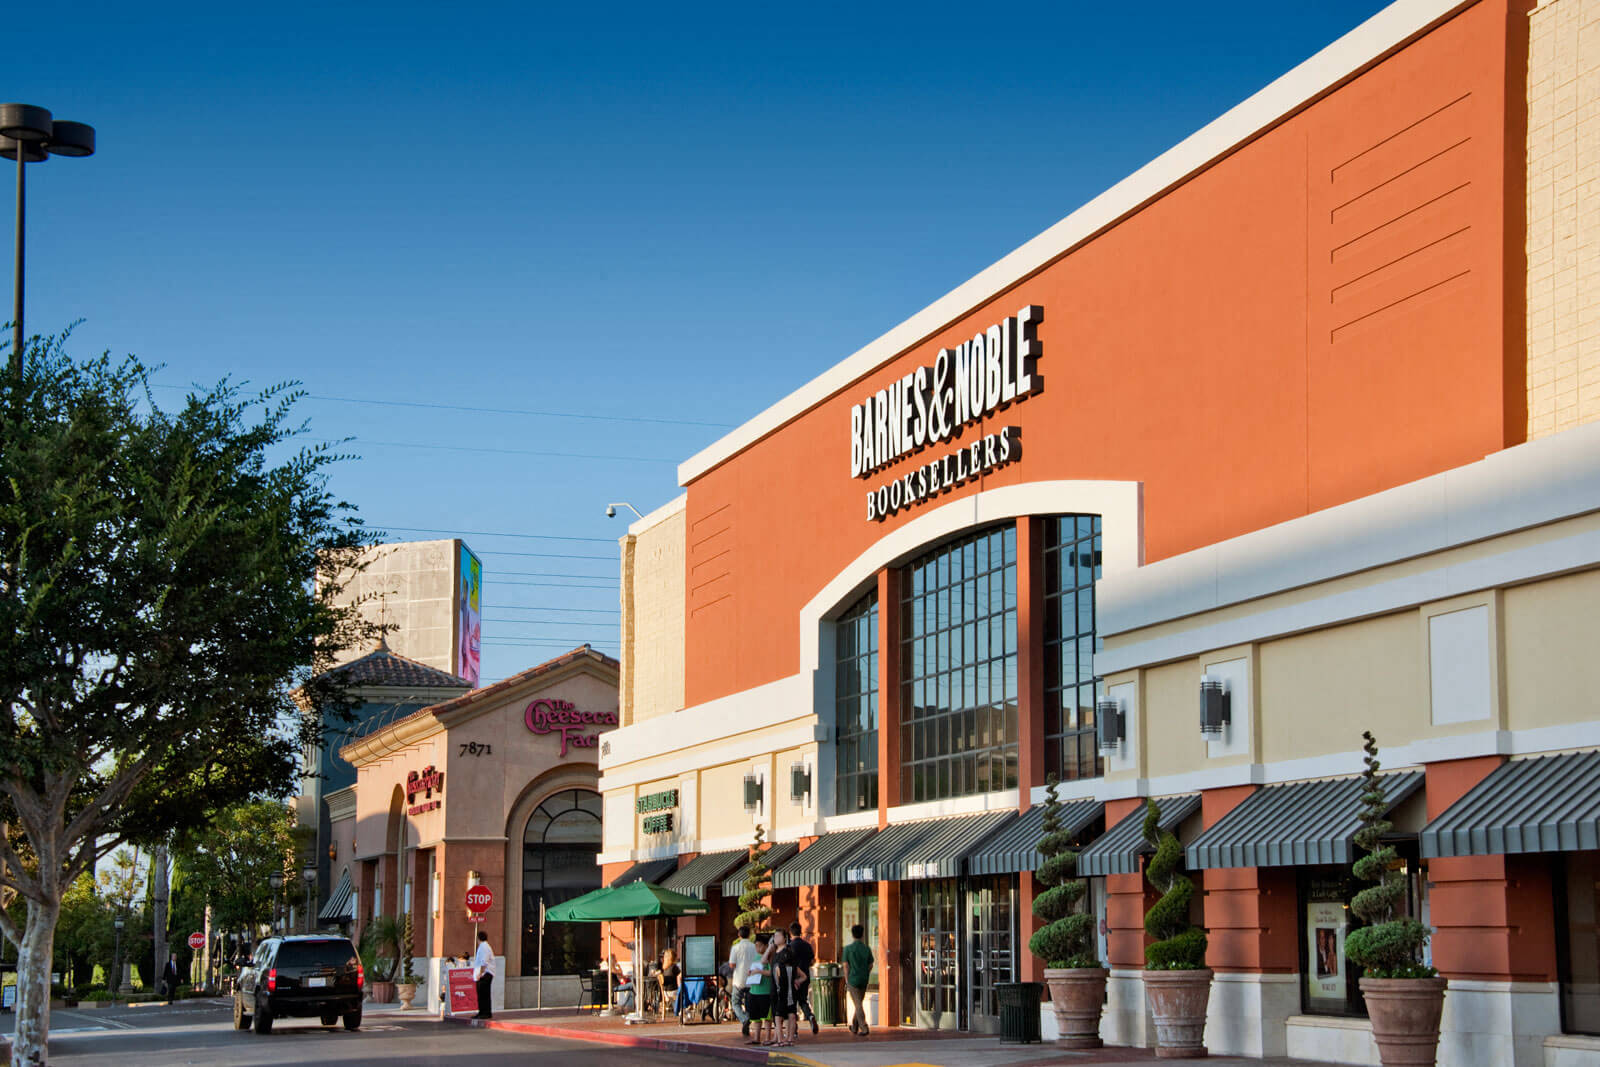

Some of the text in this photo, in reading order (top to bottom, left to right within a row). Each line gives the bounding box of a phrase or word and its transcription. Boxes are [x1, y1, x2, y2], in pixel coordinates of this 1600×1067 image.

[851, 304, 1038, 479] BARNES & NOBLE
[866, 426, 1015, 521] BOOKSELLERS
[525, 698, 619, 734] Cheeseca
[552, 700, 575, 709] The
[459, 741, 492, 757] 7871
[549, 725, 600, 757] Fac
[635, 789, 677, 815] STARBUCKS
[643, 814, 671, 834] COFFEE
[467, 894, 491, 904] STOP
[188, 936, 205, 946] STOP
